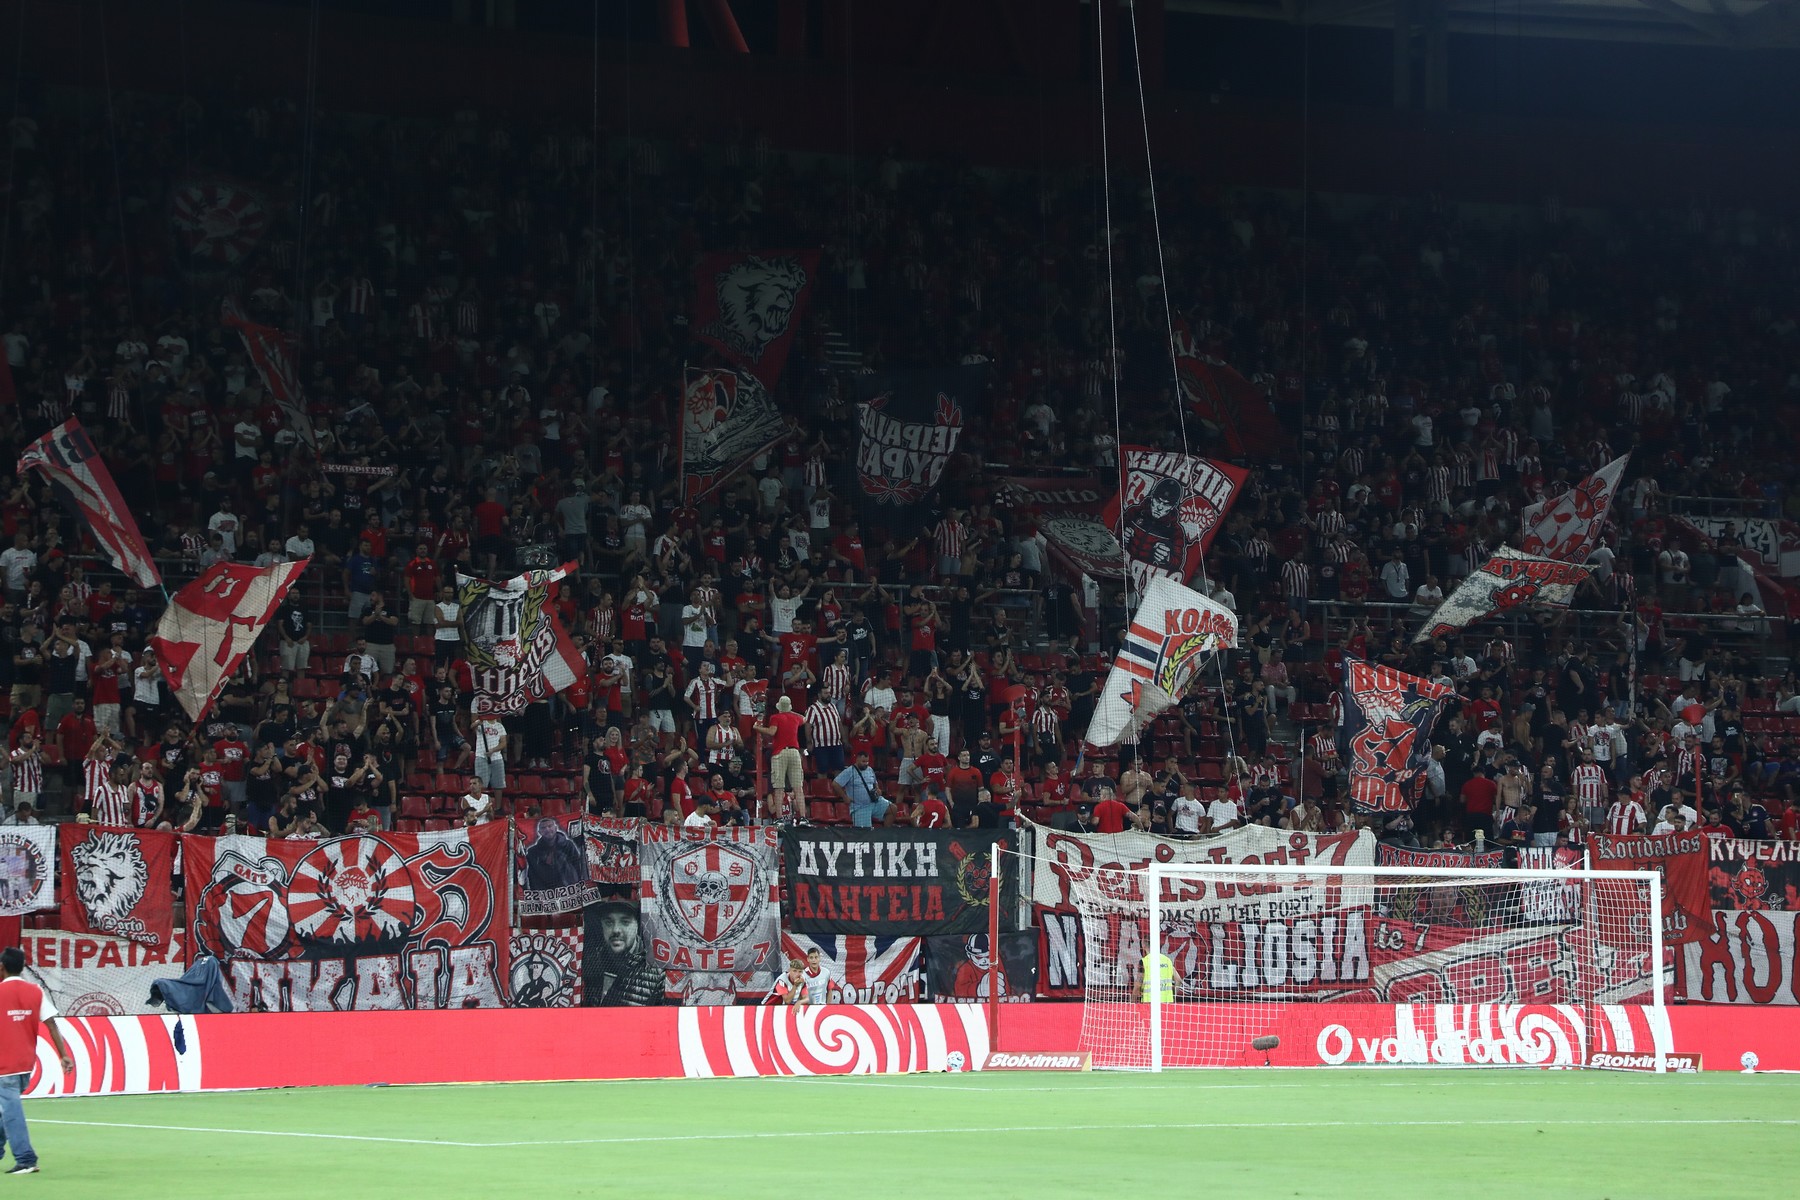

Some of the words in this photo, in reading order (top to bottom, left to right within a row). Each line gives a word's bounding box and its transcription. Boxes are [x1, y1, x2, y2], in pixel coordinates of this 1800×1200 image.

[466, 615, 557, 699] thens
[643, 823, 778, 848] MISFITS
[1594, 834, 1700, 860] Koridallos
[797, 840, 939, 877] ΔΥΤΙΚΗ
[233, 863, 268, 885] GATE
[794, 883, 946, 922] ΑΛΗΤΕΙΑ
[1200, 908, 1221, 922] OF
[1227, 902, 1261, 922] THE
[103, 914, 144, 932] Porto
[229, 889, 274, 949] 7
[1210, 910, 1371, 988] LIOSIA
[1412, 923, 1431, 952] 7
[652, 938, 735, 971] GATE
[752, 940, 771, 965] 7
[988, 1053, 1080, 1068] Stoiximan
